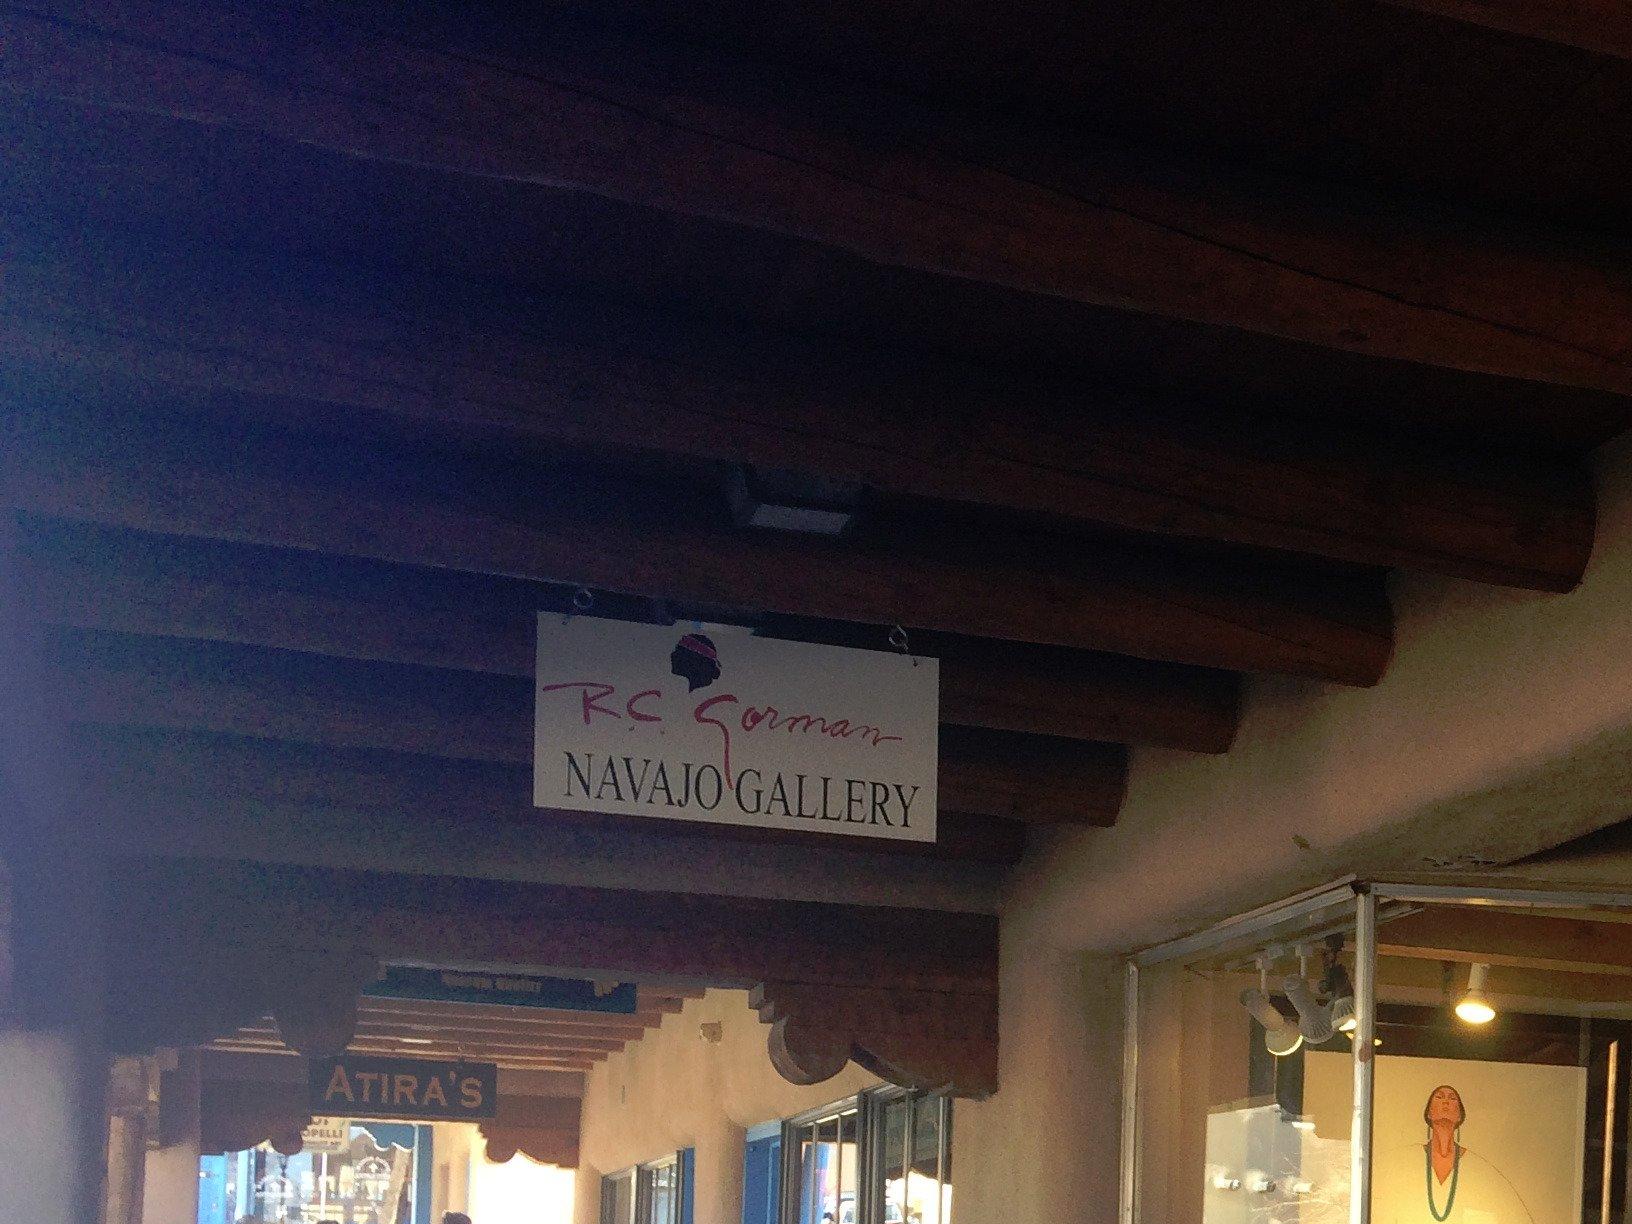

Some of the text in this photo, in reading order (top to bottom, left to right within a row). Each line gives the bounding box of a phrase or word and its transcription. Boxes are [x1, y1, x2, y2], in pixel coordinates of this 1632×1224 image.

[694, 694, 902, 789] Gorman
[563, 751, 920, 828] NAVAJO GALLERY
[301, 1127, 343, 1139] OPELLI
